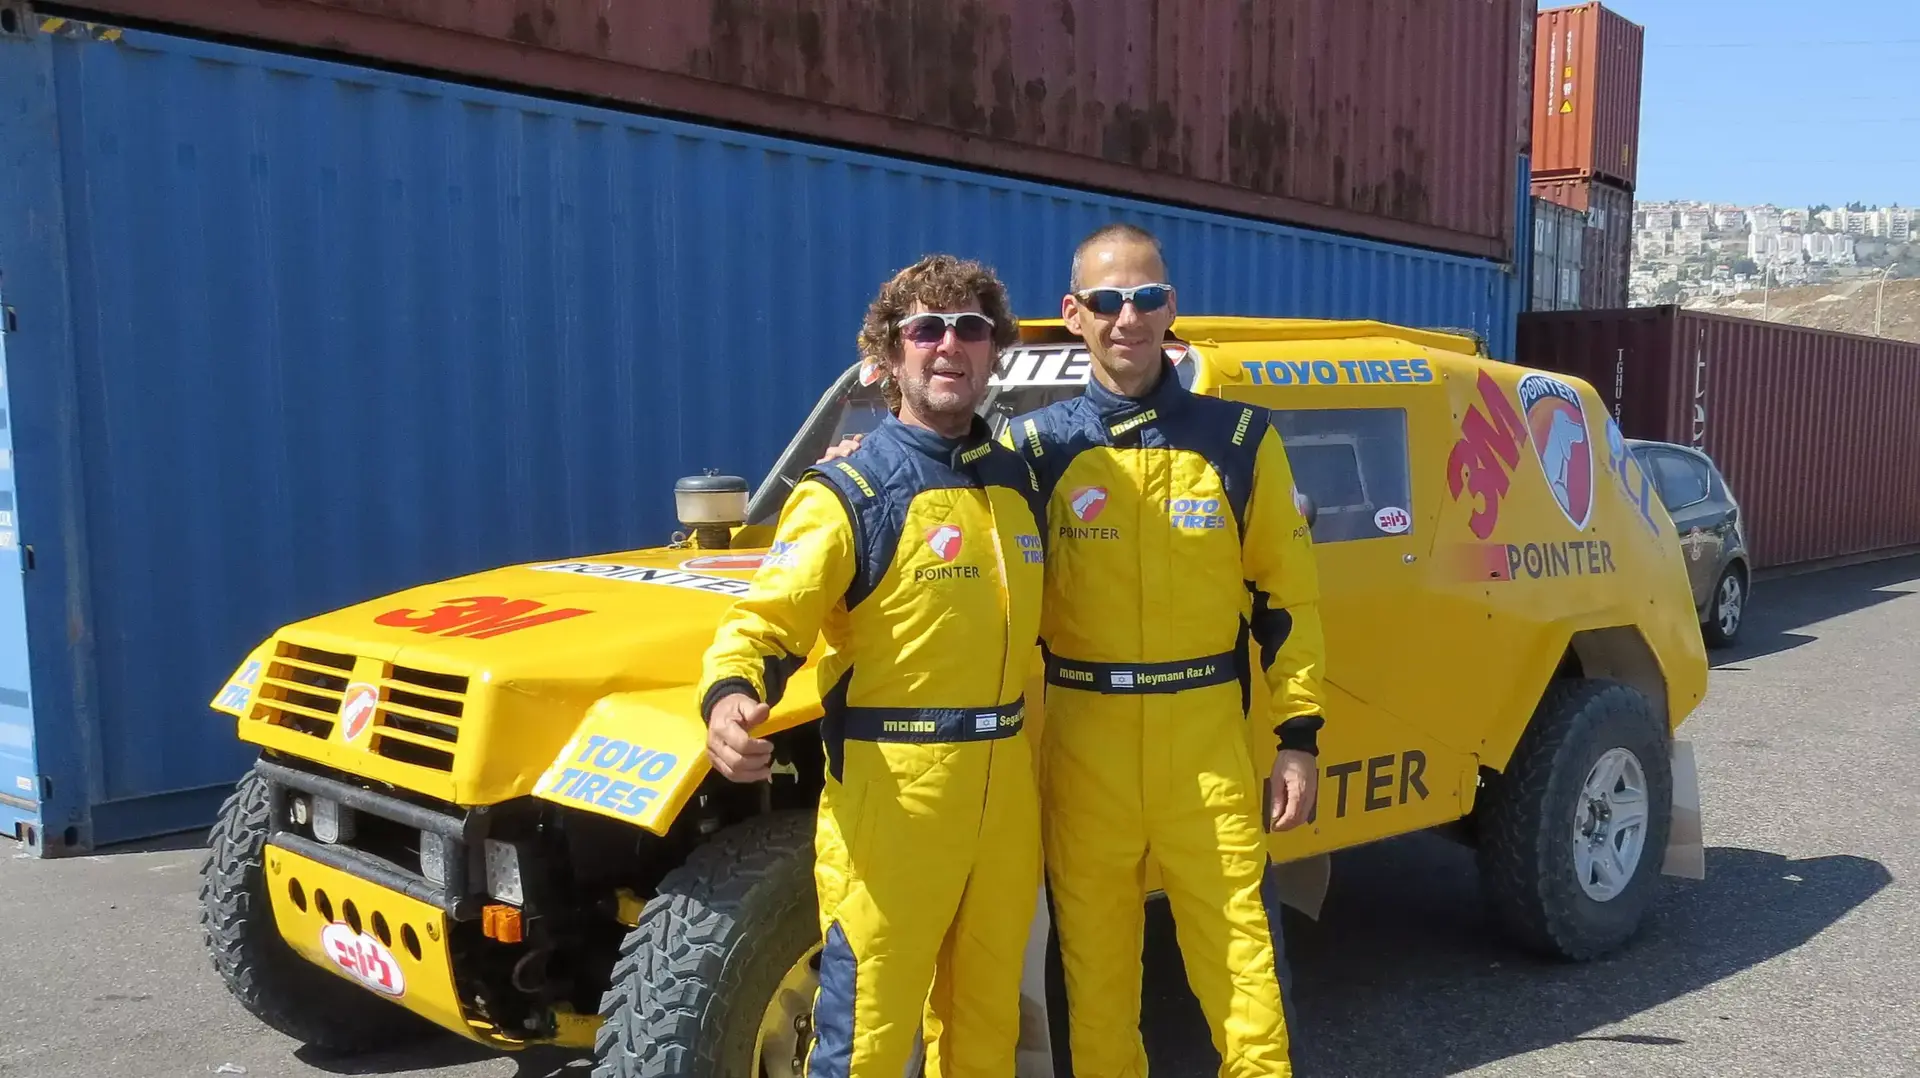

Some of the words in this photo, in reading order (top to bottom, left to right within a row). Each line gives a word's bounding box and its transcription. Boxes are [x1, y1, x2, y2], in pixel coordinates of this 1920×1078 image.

[998, 348, 1091, 381] NTE
[1241, 360, 1338, 385] TOYO
[1338, 359, 1433, 383] TIRES
[1615, 348, 1624, 399] TGHU
[1521, 377, 1579, 408] POINTER
[1447, 368, 1528, 540] 3M
[1059, 527, 1120, 540] POINTER
[1171, 515, 1225, 528] TIRES
[914, 567, 981, 582] POINTER
[1507, 541, 1616, 579] POINTER
[547, 563, 750, 595] POINTE
[374, 596, 595, 640] 3M
[1136, 668, 1184, 685] Heymann
[1186, 667, 1204, 679] Raz
[578, 735, 677, 782] TOYO
[550, 767, 660, 817] TIRES
[1262, 749, 1430, 834] TER
